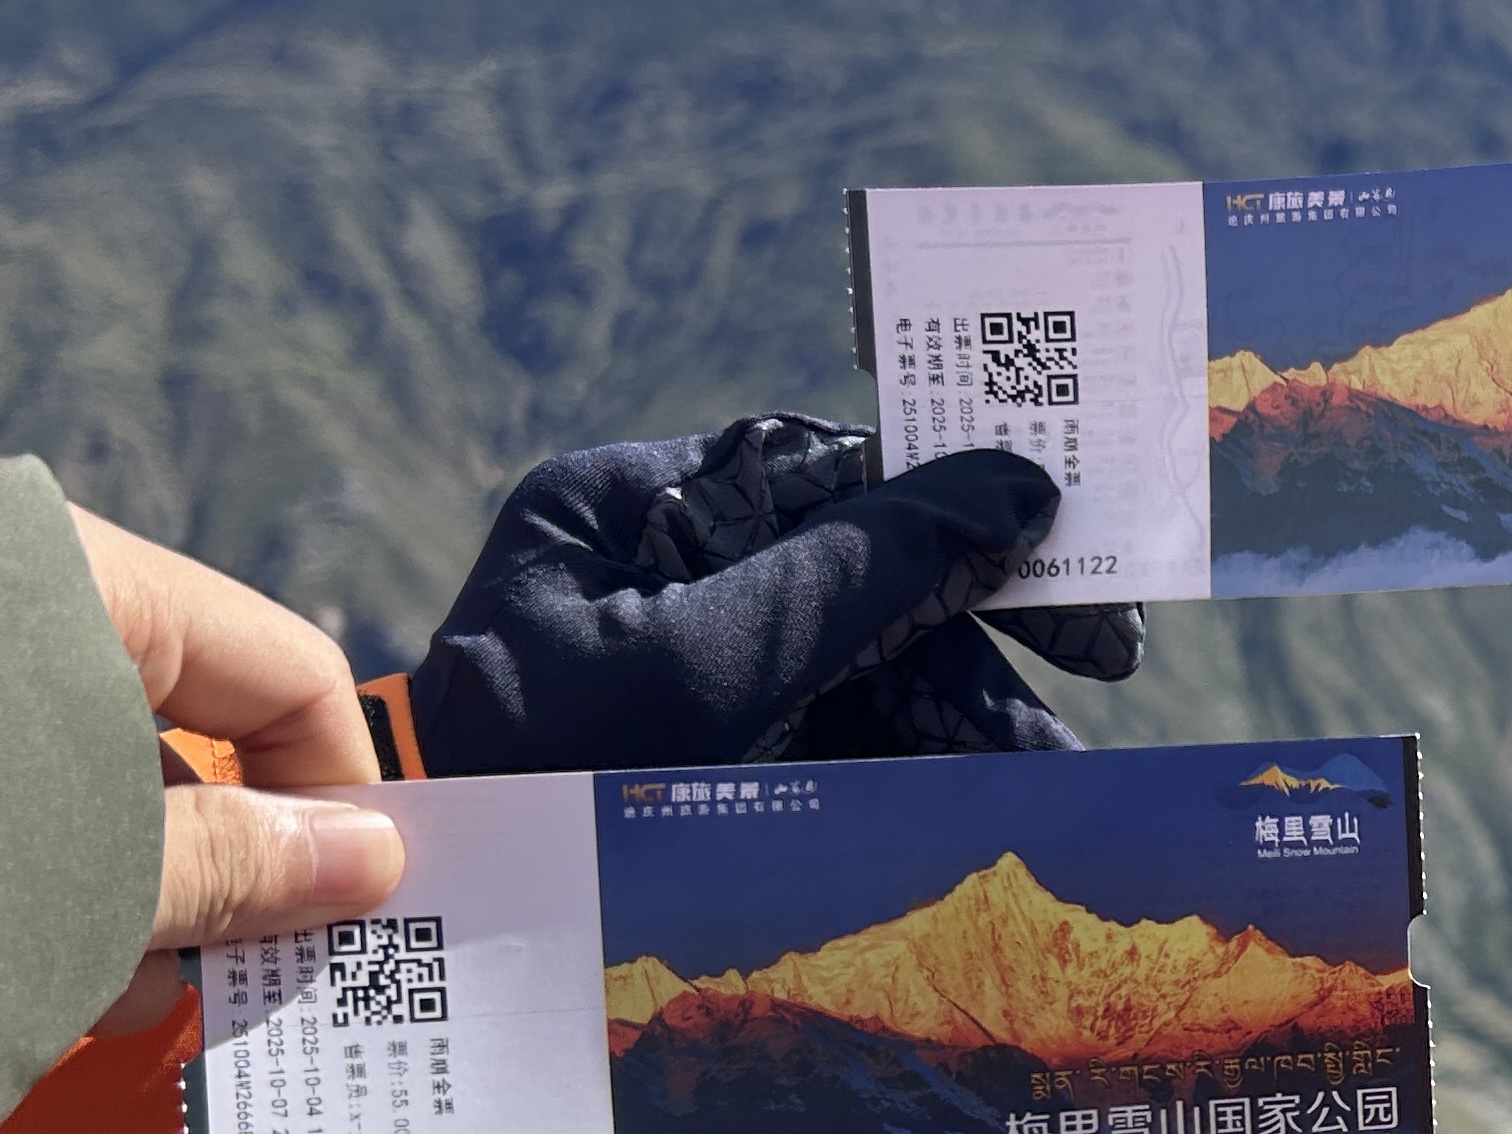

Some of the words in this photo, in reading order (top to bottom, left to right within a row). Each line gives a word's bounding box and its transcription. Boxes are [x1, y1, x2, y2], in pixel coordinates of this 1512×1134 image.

[953, 318, 975, 449] 出票时间:2025-1
[1018, 556, 1118, 579] 0061122
[1255, 811, 1360, 847] 梅里雪山
[1258, 849, 1281, 858] Meili
[1283, 847, 1311, 857] Snow
[1313, 846, 1359, 856] Mountain
